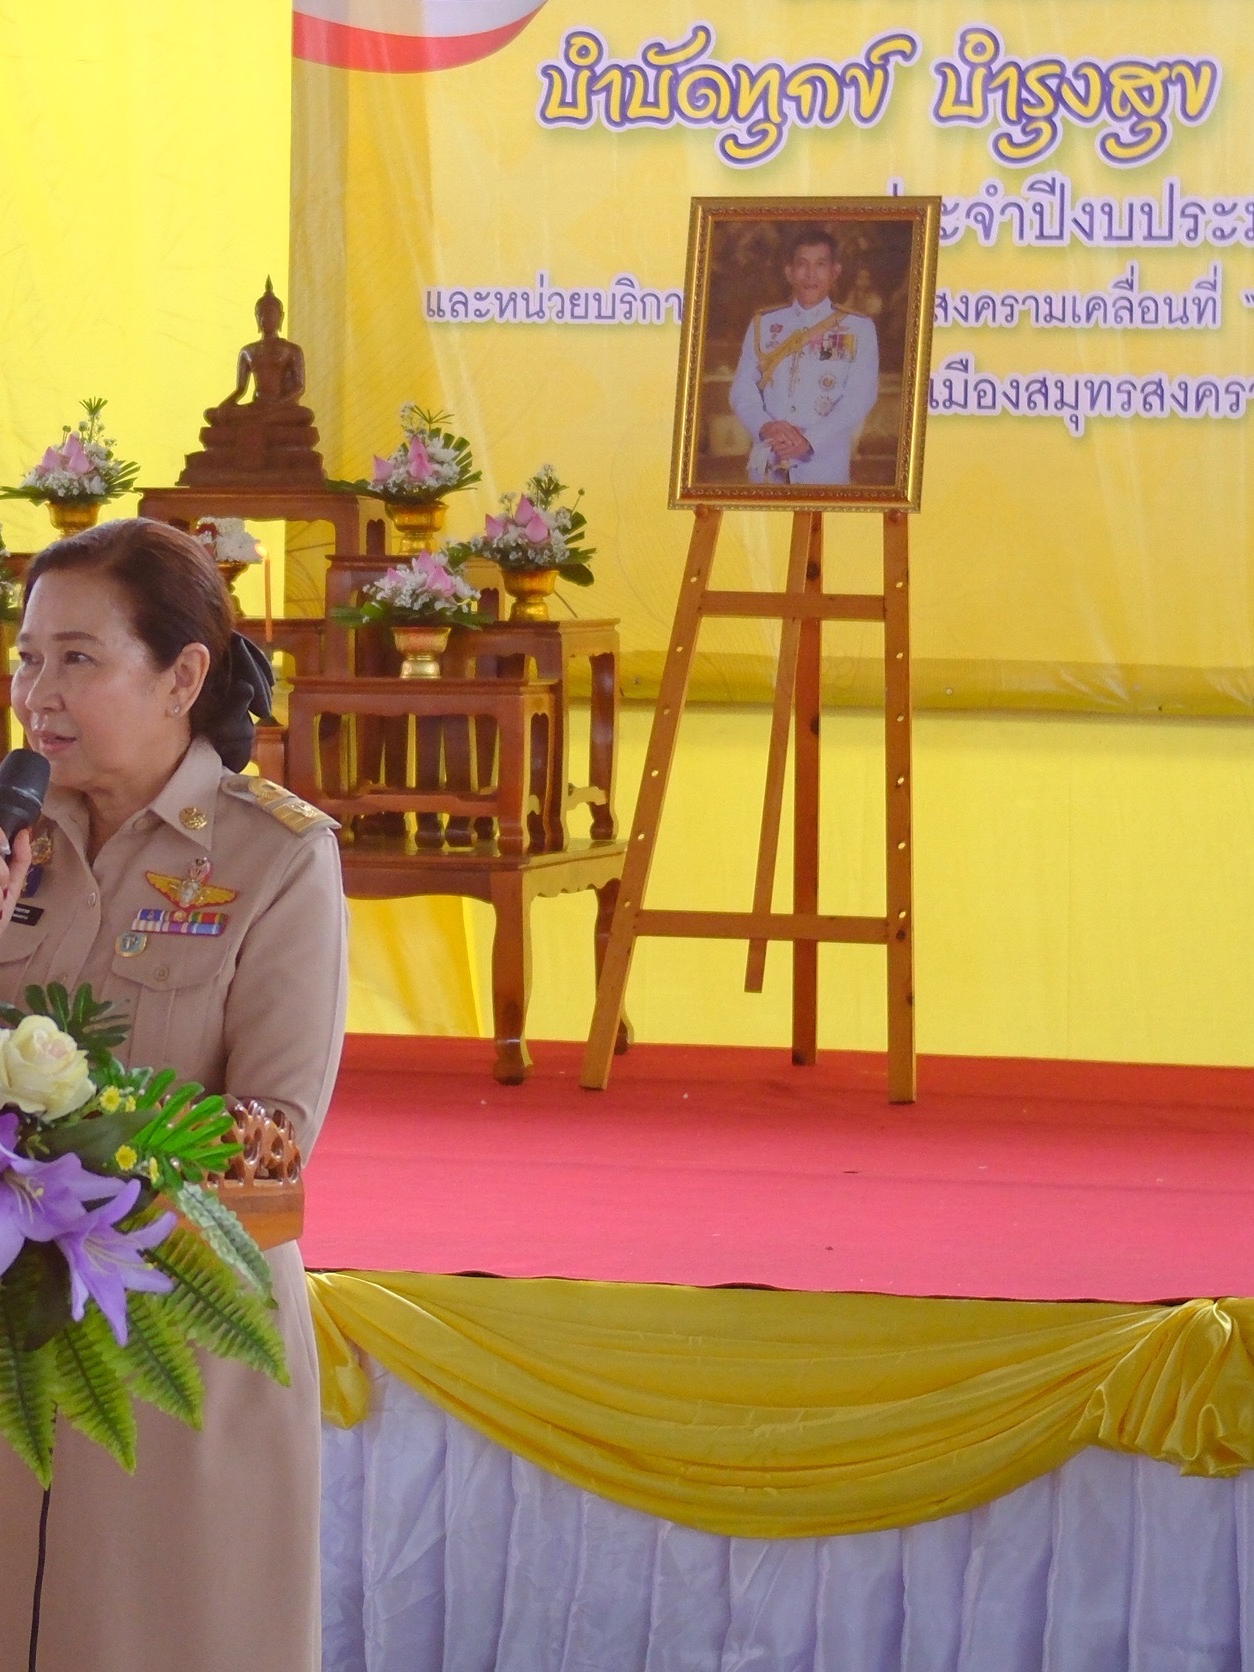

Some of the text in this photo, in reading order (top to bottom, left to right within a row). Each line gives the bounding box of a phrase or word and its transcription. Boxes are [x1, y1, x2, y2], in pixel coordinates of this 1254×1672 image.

[539, 24, 1218, 166] บำบัดทุกข์ บำรุงสุข
[892, 176, 1254, 242] ะจำปีงบประ
